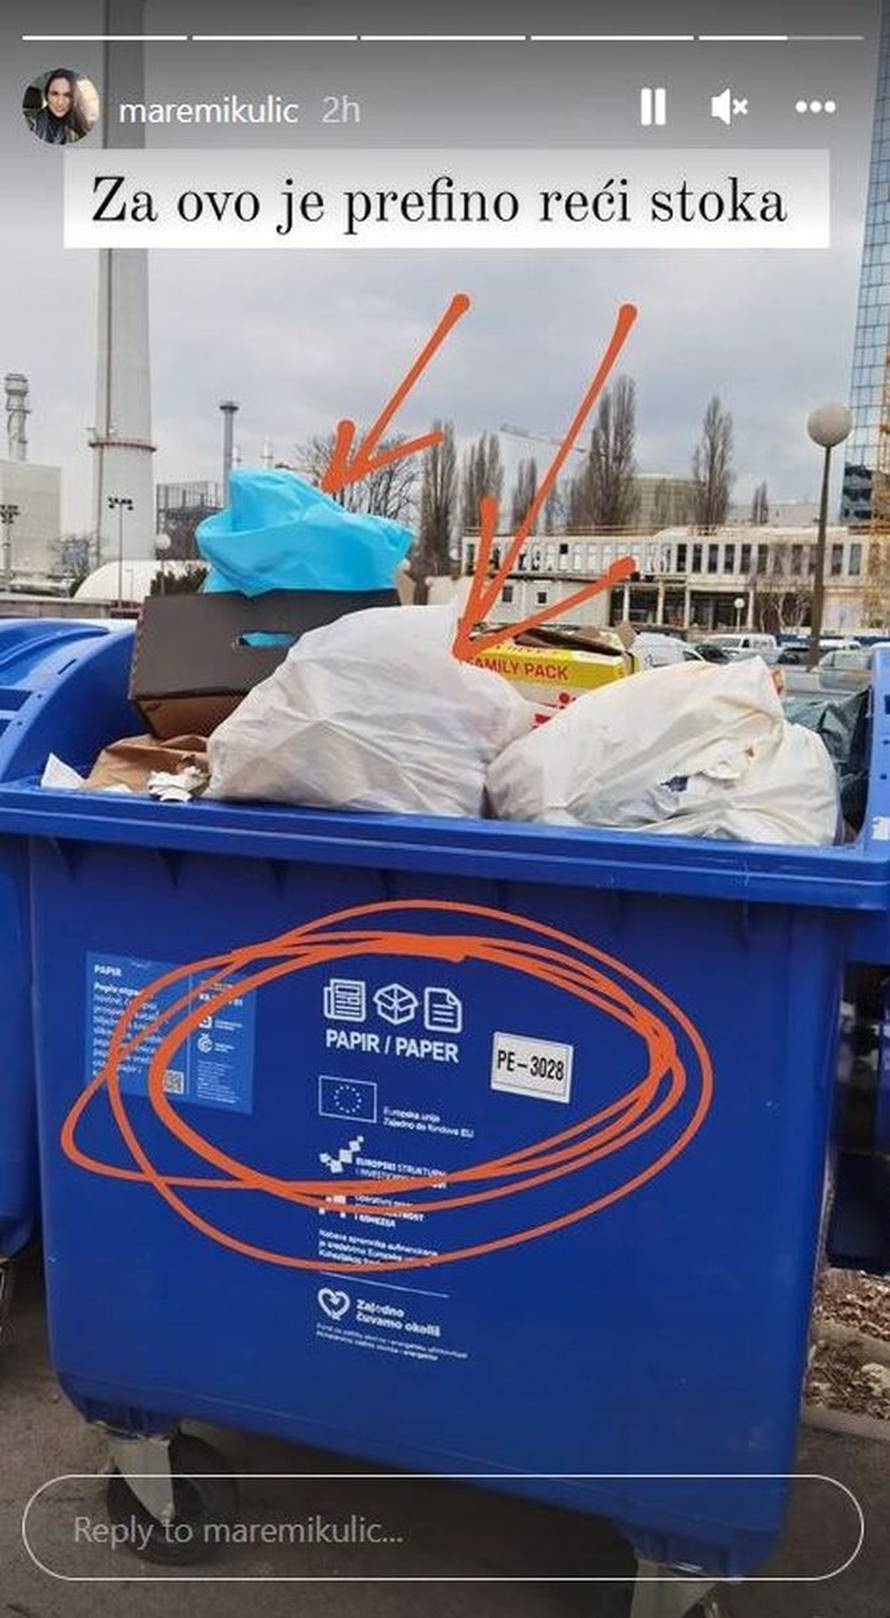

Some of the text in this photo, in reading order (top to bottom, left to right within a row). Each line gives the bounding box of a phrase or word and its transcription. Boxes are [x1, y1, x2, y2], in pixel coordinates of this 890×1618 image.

[525, 663, 569, 680] PACK
[325, 1028, 460, 1064] PAPIR / PAPER
